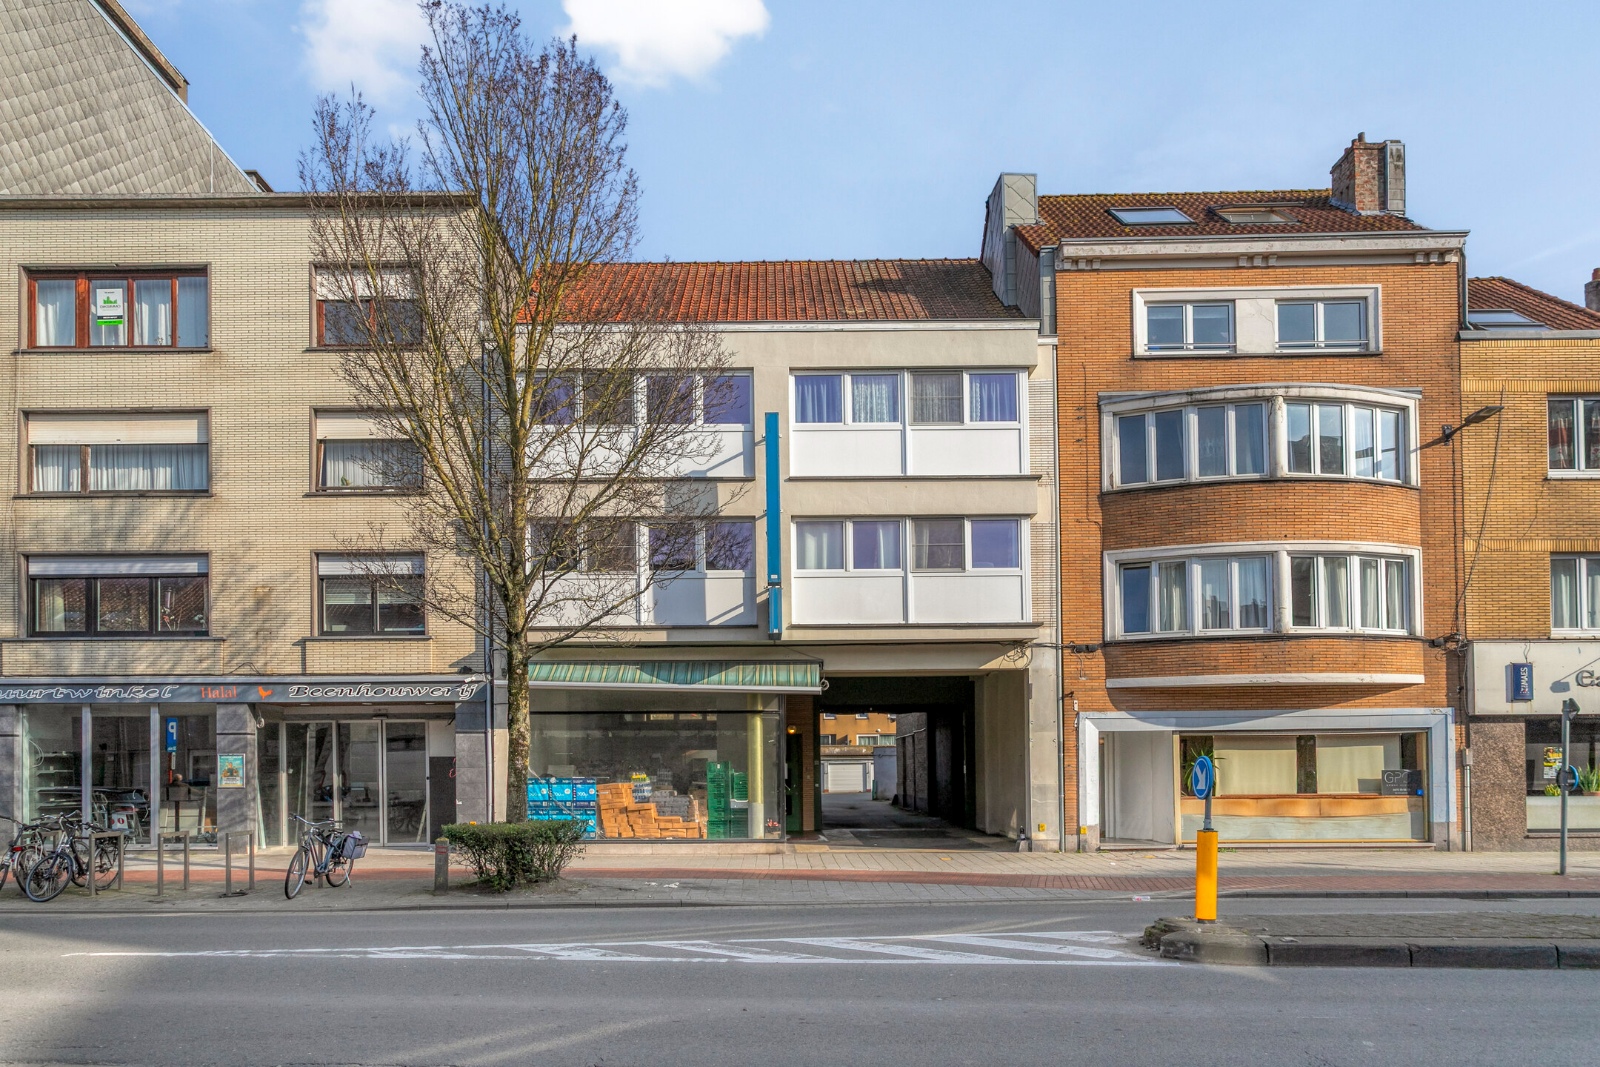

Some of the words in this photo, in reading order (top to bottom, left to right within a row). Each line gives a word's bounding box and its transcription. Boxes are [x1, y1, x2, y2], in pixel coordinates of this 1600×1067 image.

[1520, 667, 1528, 692] MAES
[201, 686, 237, 698] Halal
[289, 684, 477, 700] Beenhouwerij
